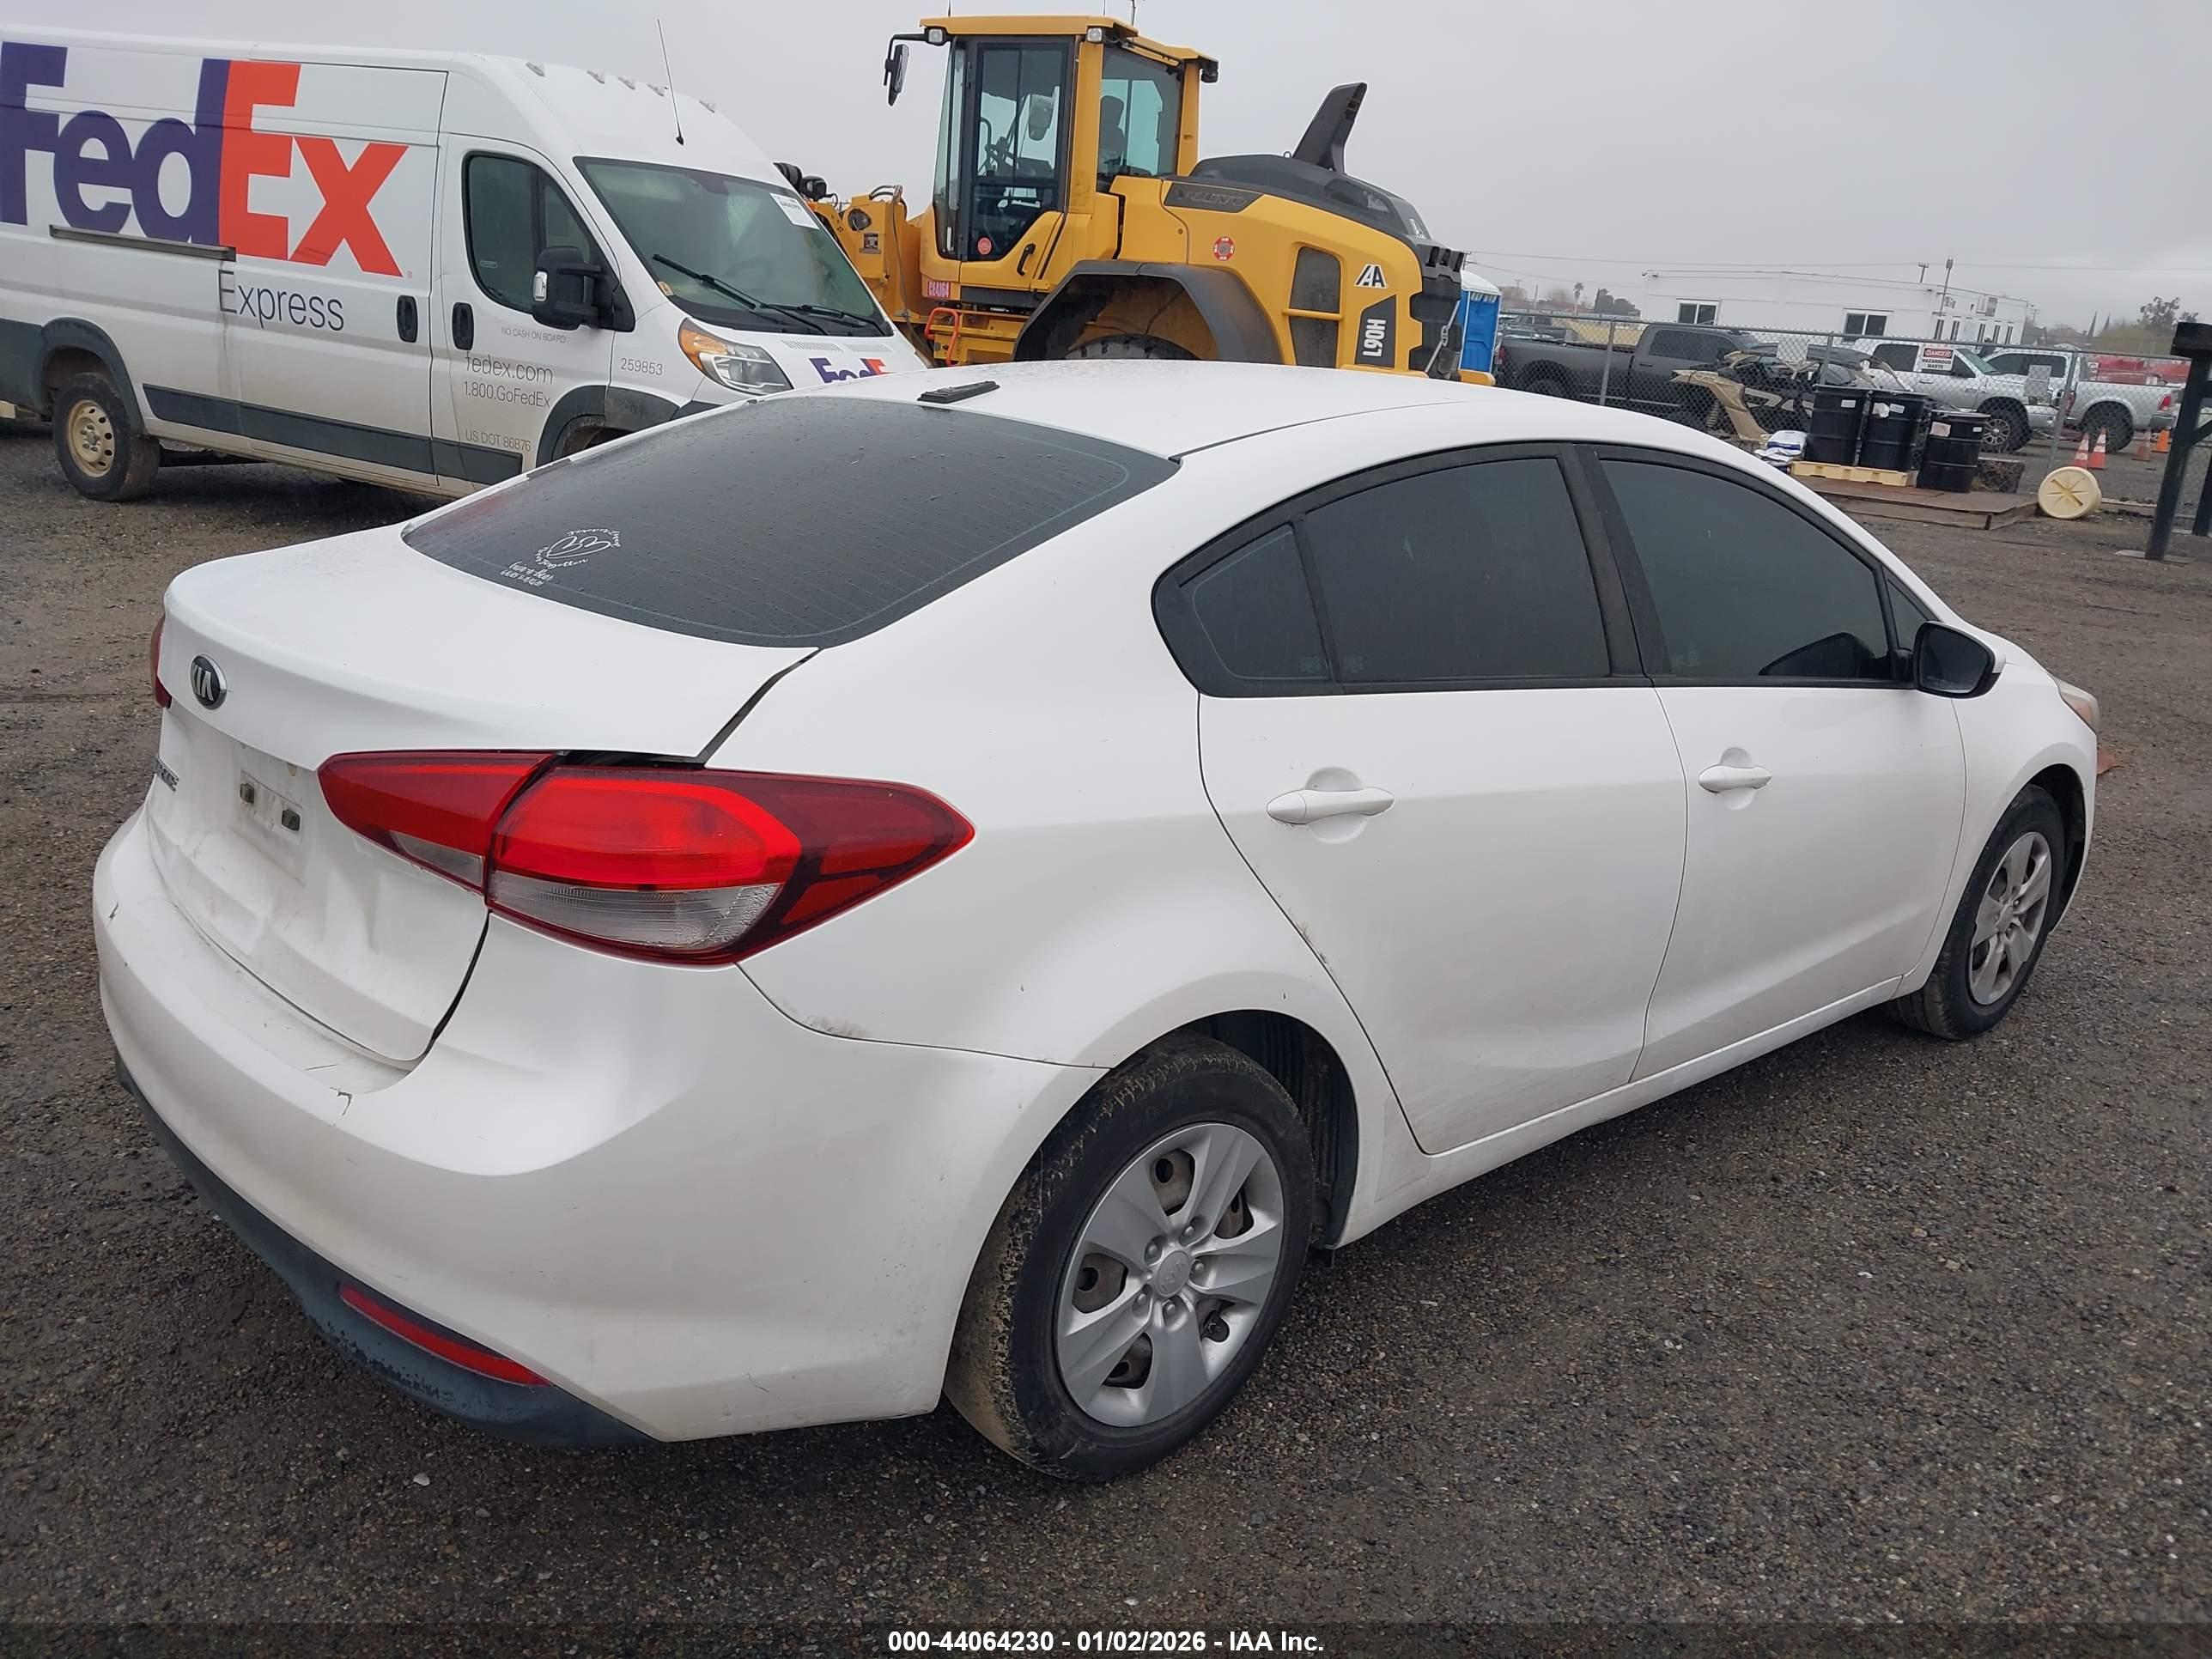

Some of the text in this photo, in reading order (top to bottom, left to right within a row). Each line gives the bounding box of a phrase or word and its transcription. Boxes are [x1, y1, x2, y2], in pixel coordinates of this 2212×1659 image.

[0, 40, 409, 277] FedEx
[218, 269, 344, 331] Express
[501, 327, 567, 343] NO CASH ON BOARD
[1362, 318, 1386, 357] L90H
[465, 350, 554, 385] fedex.com
[620, 357, 663, 376] 259853
[1926, 349, 1952, 357] DANGER
[463, 380, 551, 409] 1.800.GoFedEx
[465, 428, 479, 442] US
[481, 432, 501, 447] DOT
